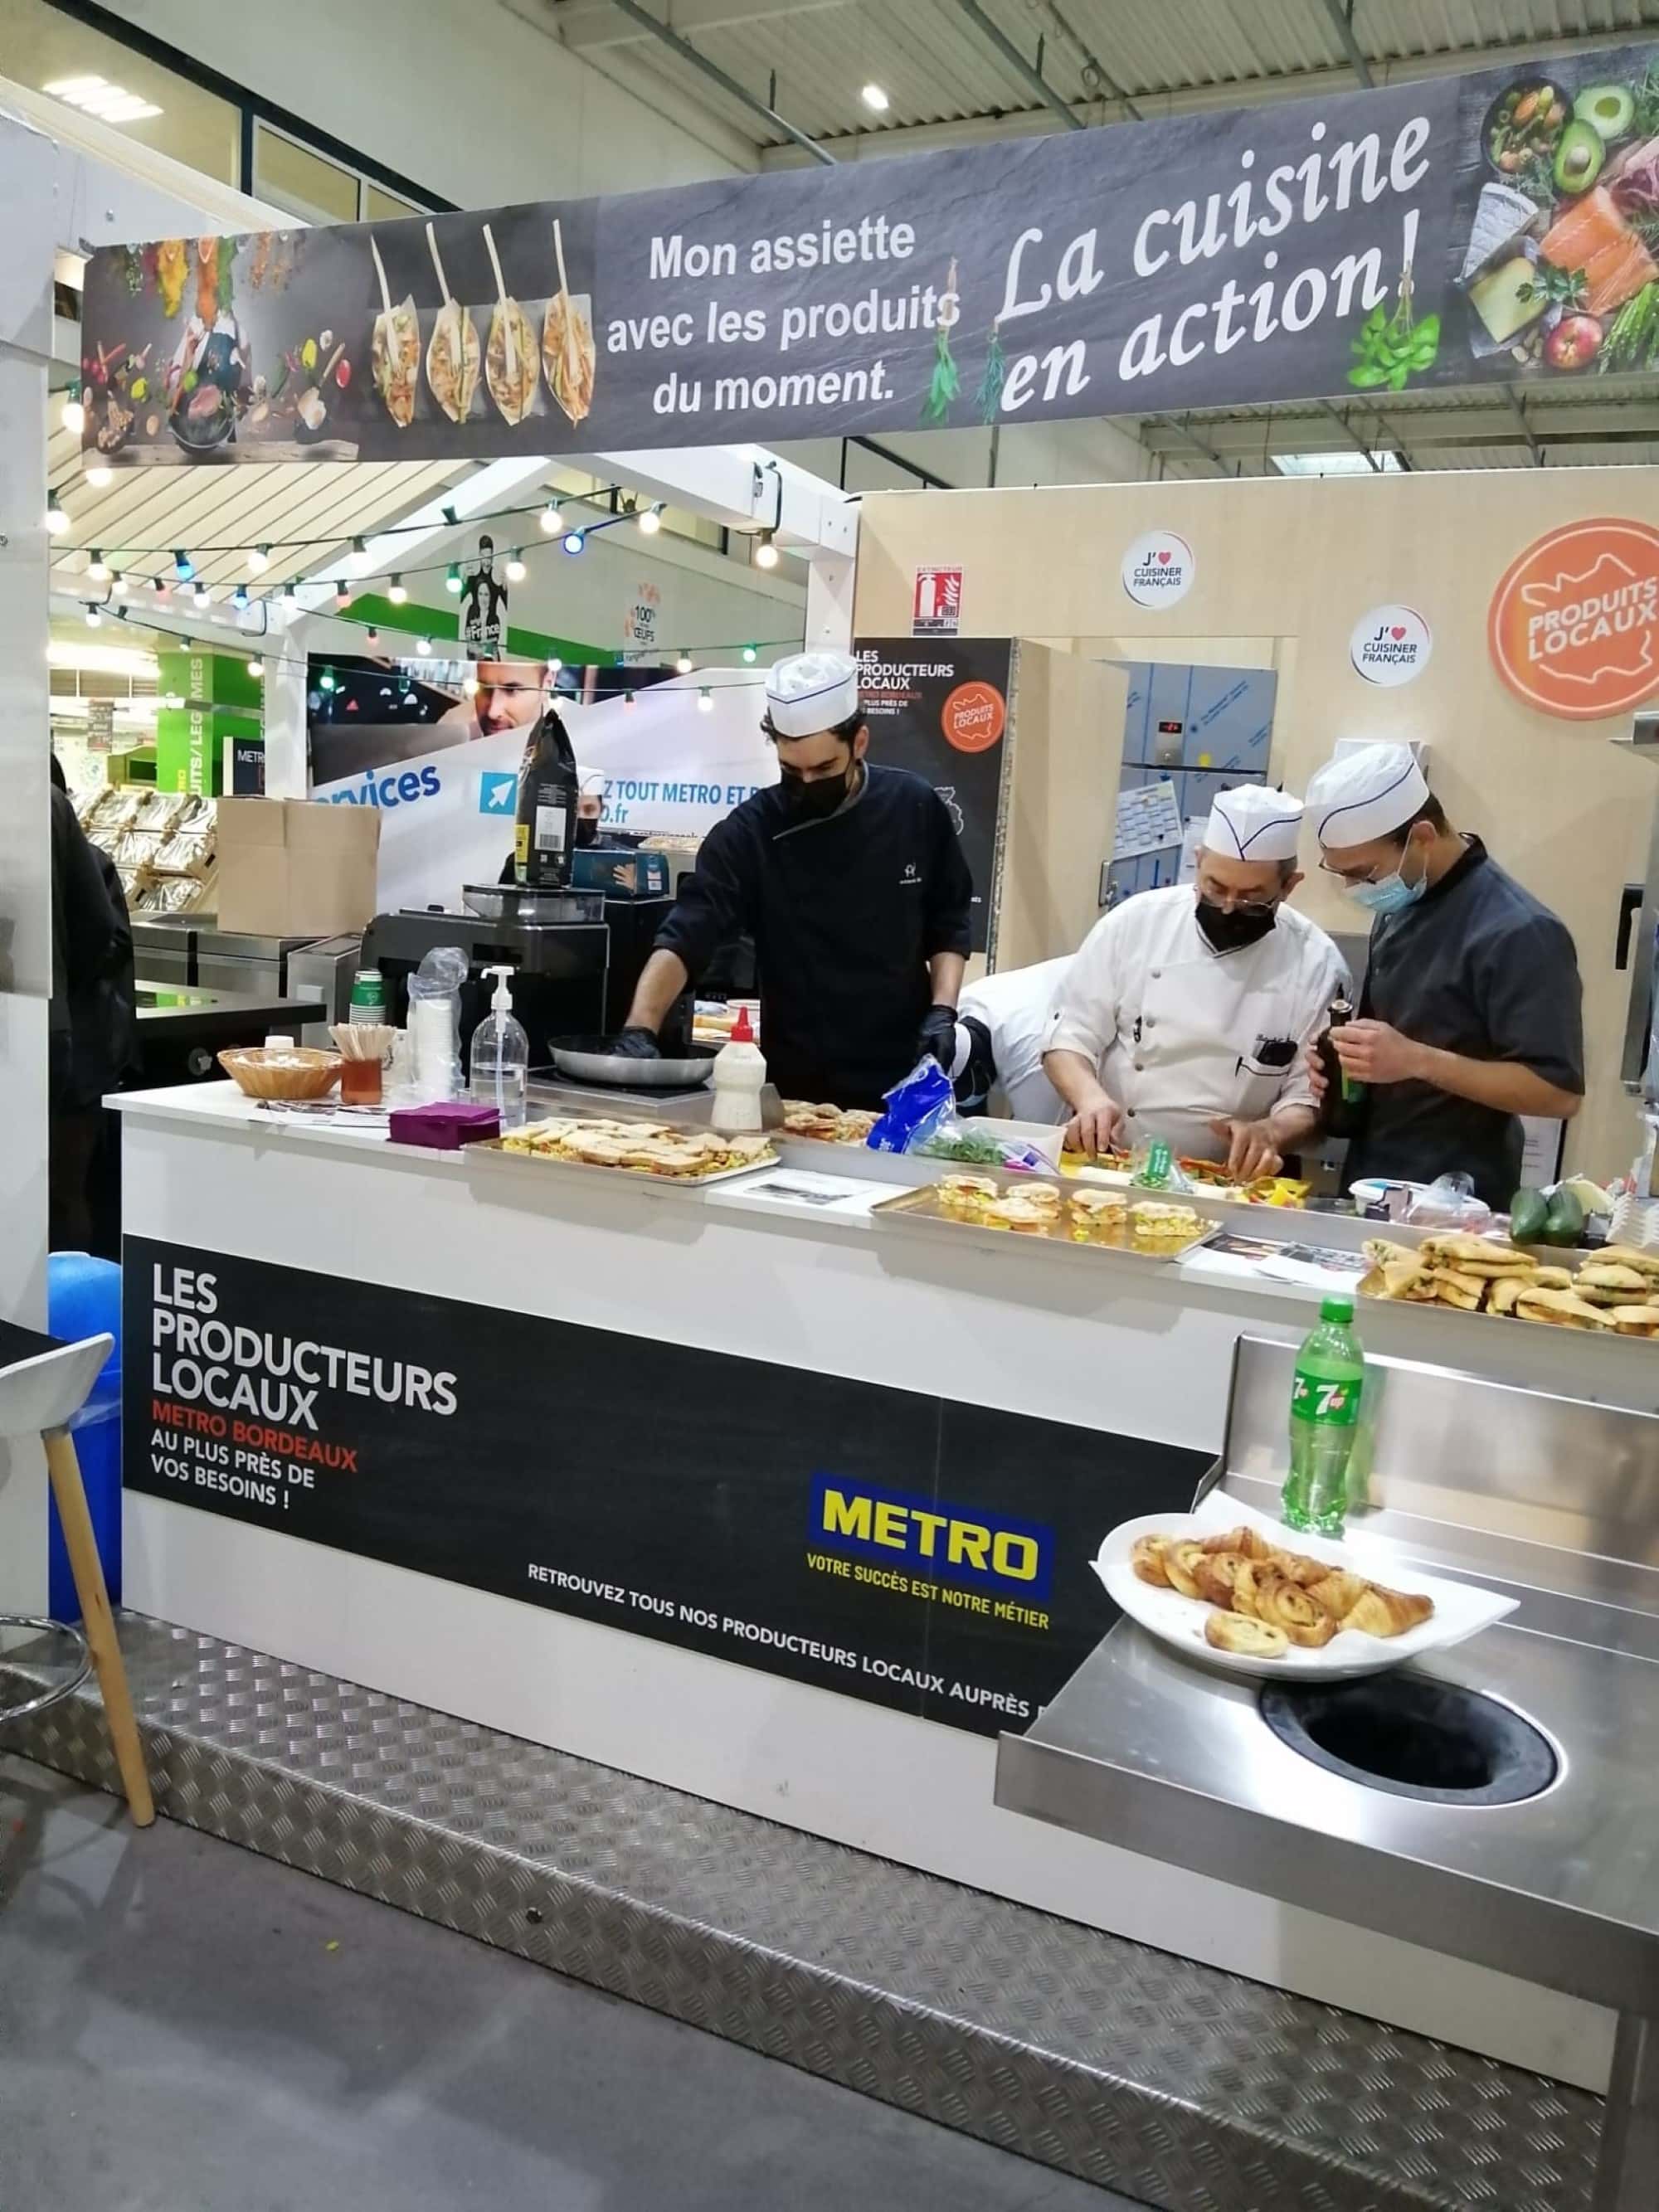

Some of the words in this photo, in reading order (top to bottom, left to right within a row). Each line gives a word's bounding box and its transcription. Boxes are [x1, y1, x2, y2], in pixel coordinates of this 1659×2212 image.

[649, 234, 737, 280] Mon
[750, 215, 915, 275] assiette
[995, 226, 1105, 324] La
[1133, 115, 1432, 278] cuisine
[606, 310, 693, 353] avec
[707, 301, 766, 344] les
[780, 284, 961, 352] produits
[653, 372, 701, 415] du
[714, 360, 894, 411] moment.
[1000, 338, 1091, 413] en
[1132, 577, 1182, 588] FRANÇAIS
[1134, 567, 1182, 577] CUISINER
[1529, 576, 1658, 639] PRODUITS
[1529, 599, 1658, 663] LOCAUX
[855, 650, 878, 663] LES
[856, 664, 954, 677] PRODUCTEURS
[1362, 654, 1417, 665] FRANÇAIS
[1364, 643, 1418, 654] CUISINER
[190, 658, 203, 745] LEGMES
[955, 713, 994, 729] LOCAUX
[190, 747, 203, 795] UITS/
[237, 749, 265, 763] METR
[616, 780, 659, 800] TOUT
[662, 783, 721, 804] METRO
[727, 785, 747, 805] ET
[153, 1263, 218, 1314] LES
[153, 1307, 458, 1415] PRODUCTEURS
[153, 1353, 319, 1431] LOCAUX
[151, 1428, 178, 1451] AU
[183, 1436, 229, 1465] PLUS
[235, 1451, 281, 1480] PRÈS
[288, 1464, 315, 1489] DE
[153, 1399, 227, 1437] METRO
[232, 1421, 358, 1473] BORDEAUX
[151, 1453, 189, 1481] VOS
[195, 1466, 276, 1505] BESOINS
[822, 1489, 1039, 1581] METRO
[807, 1552, 851, 1578] VOTRE
[854, 1565, 908, 1593] SUCCÈS
[912, 1580, 938, 1601] EST
[941, 1587, 991, 1615] NOTRE
[994, 1601, 1049, 1630] MÉTIER
[528, 1563, 625, 1603] RETROUVEZ
[629, 1591, 675, 1617] TOUS
[679, 1605, 718, 1629] NOS
[722, 1616, 857, 1668] PRODUCTEURS
[862, 1655, 945, 1694] LOCAUX
[948, 1681, 1029, 1718] AUPRÈS
